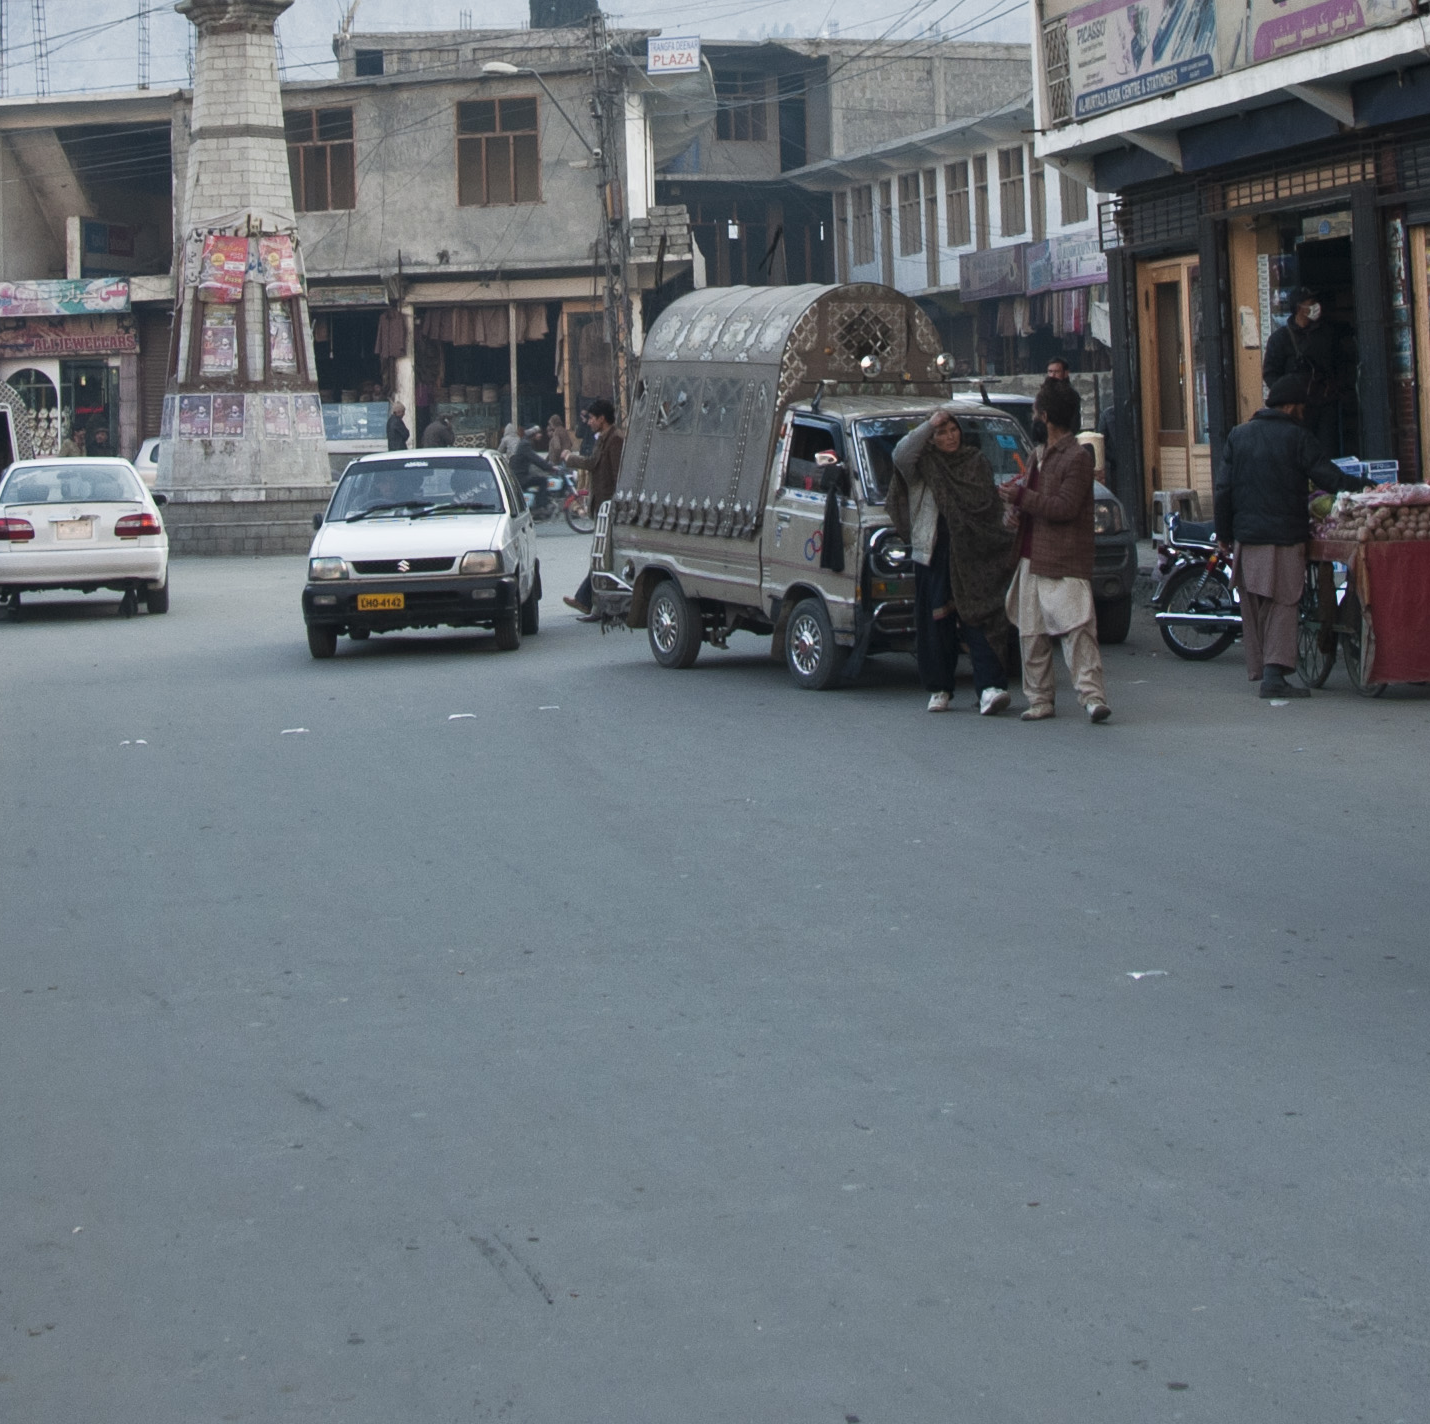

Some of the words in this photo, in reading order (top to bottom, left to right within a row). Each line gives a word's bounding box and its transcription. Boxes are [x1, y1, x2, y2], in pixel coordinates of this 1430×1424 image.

[653, 53, 694, 67] PLAZA
[1107, 87, 1121, 106] BOOK
[1121, 81, 1141, 101] CENTRE
[98, 281, 128, 302] علی
[34, 337, 55, 352] ALI
[57, 334, 137, 351] JEWELLARS
